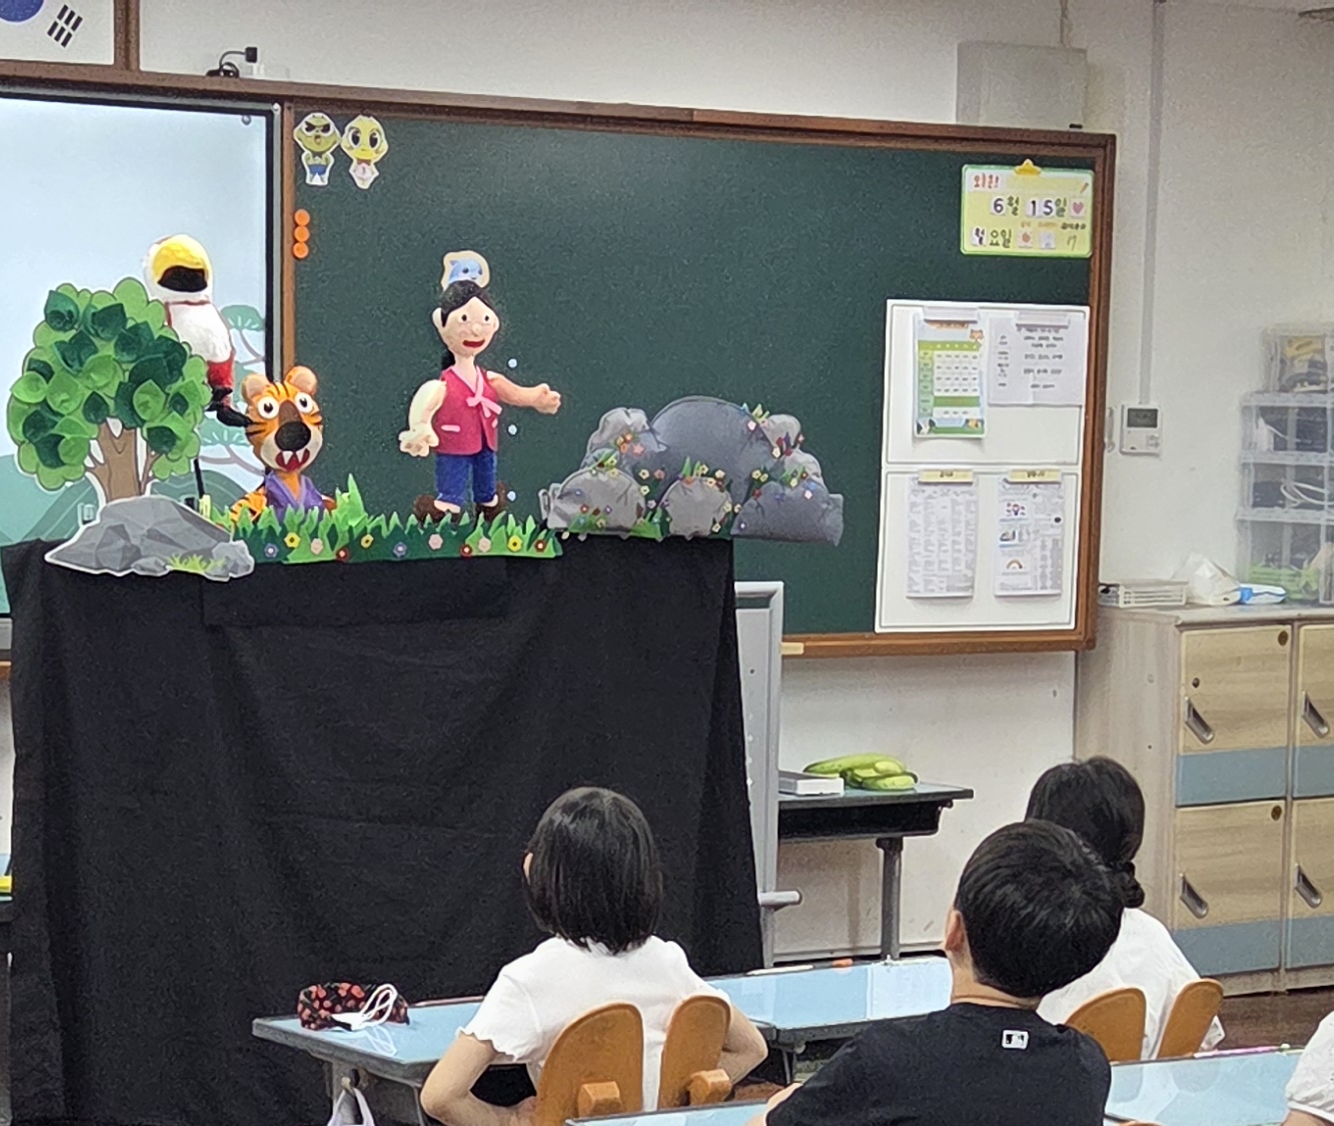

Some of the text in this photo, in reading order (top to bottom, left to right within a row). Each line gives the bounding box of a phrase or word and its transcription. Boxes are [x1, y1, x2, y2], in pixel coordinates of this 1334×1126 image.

[993, 196, 1067, 217] 6월 15일
[974, 227, 1012, 248] 월요일
